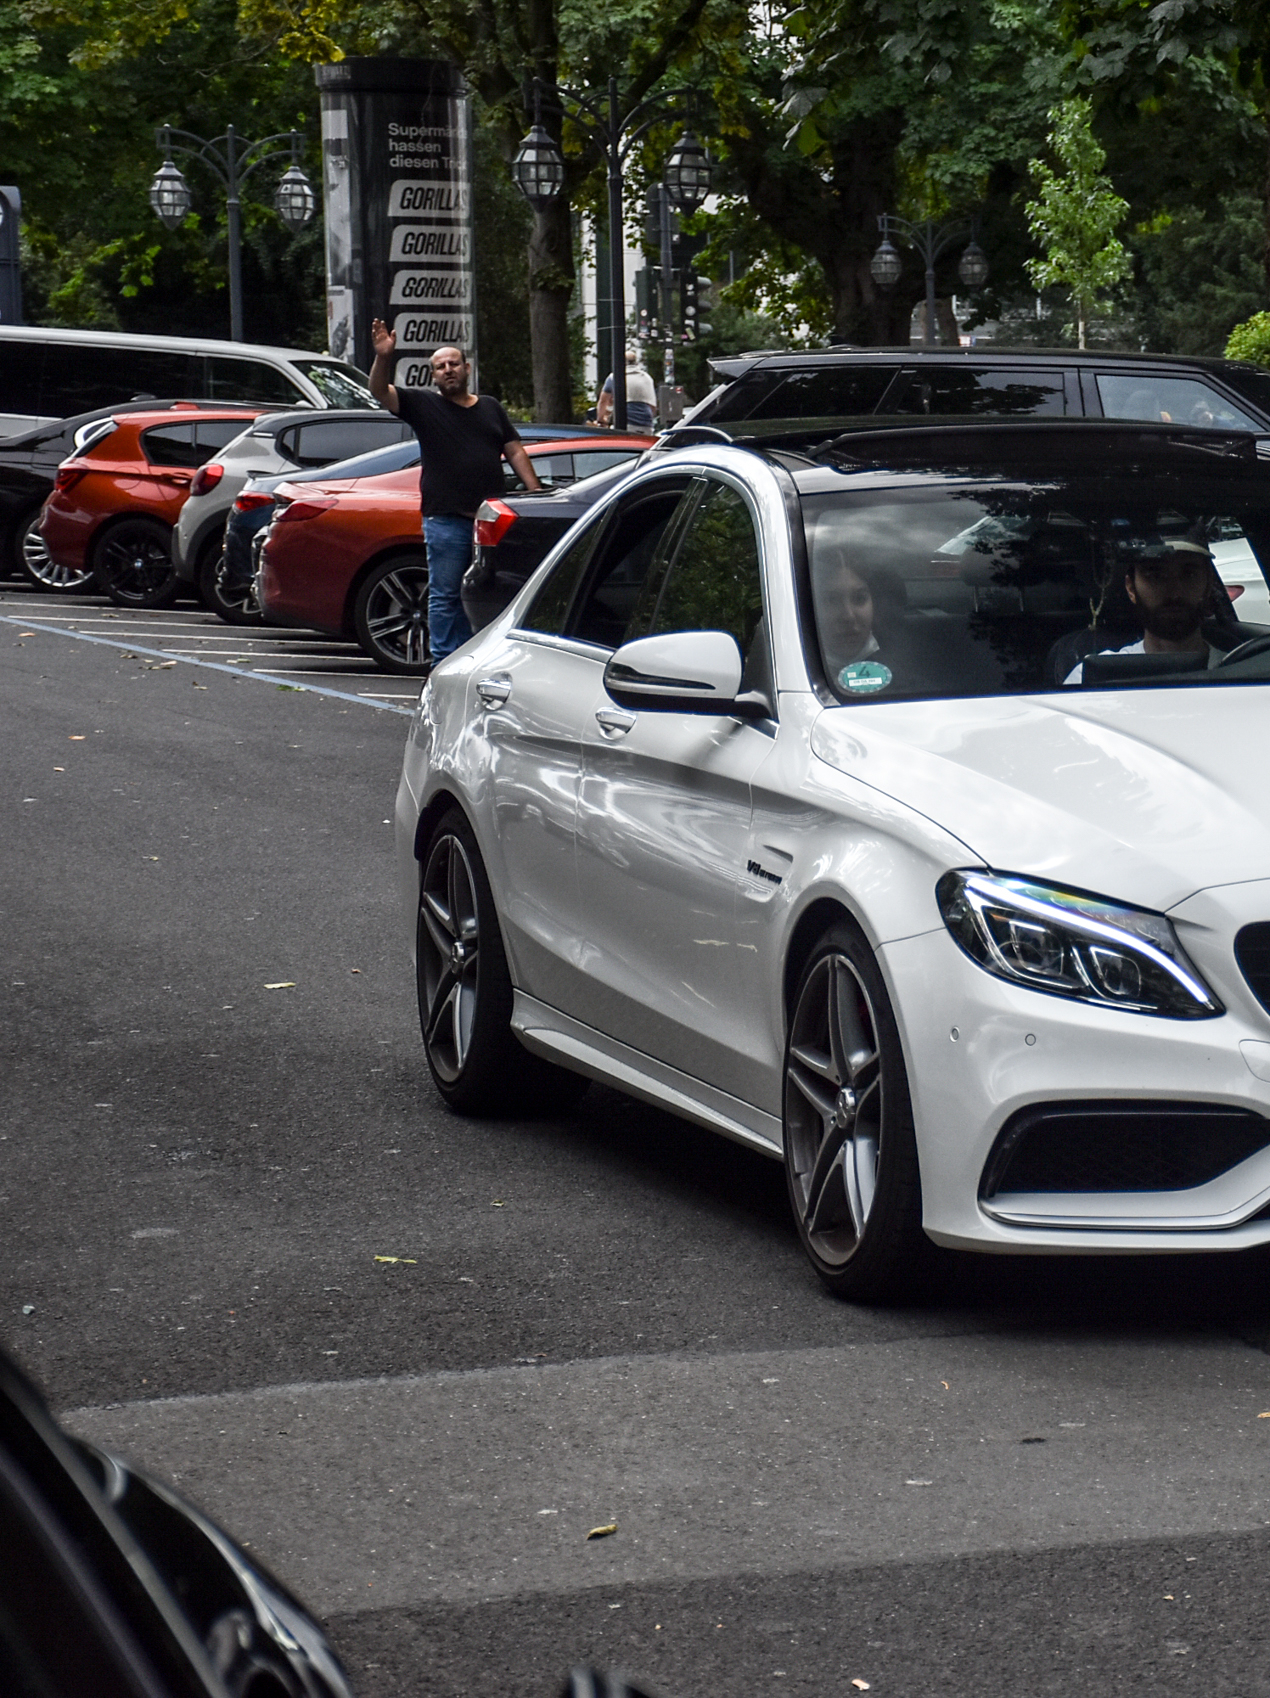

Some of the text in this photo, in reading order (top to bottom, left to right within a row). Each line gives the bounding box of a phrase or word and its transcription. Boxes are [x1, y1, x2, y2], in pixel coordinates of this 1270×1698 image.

[388, 138, 442, 153] hassen
[389, 154, 440, 168] diesen
[400, 187, 468, 212] GORILLAS
[402, 232, 468, 257] GORILLAS
[402, 277, 467, 298] GORILLAS
[403, 320, 470, 342] GORILLAS
